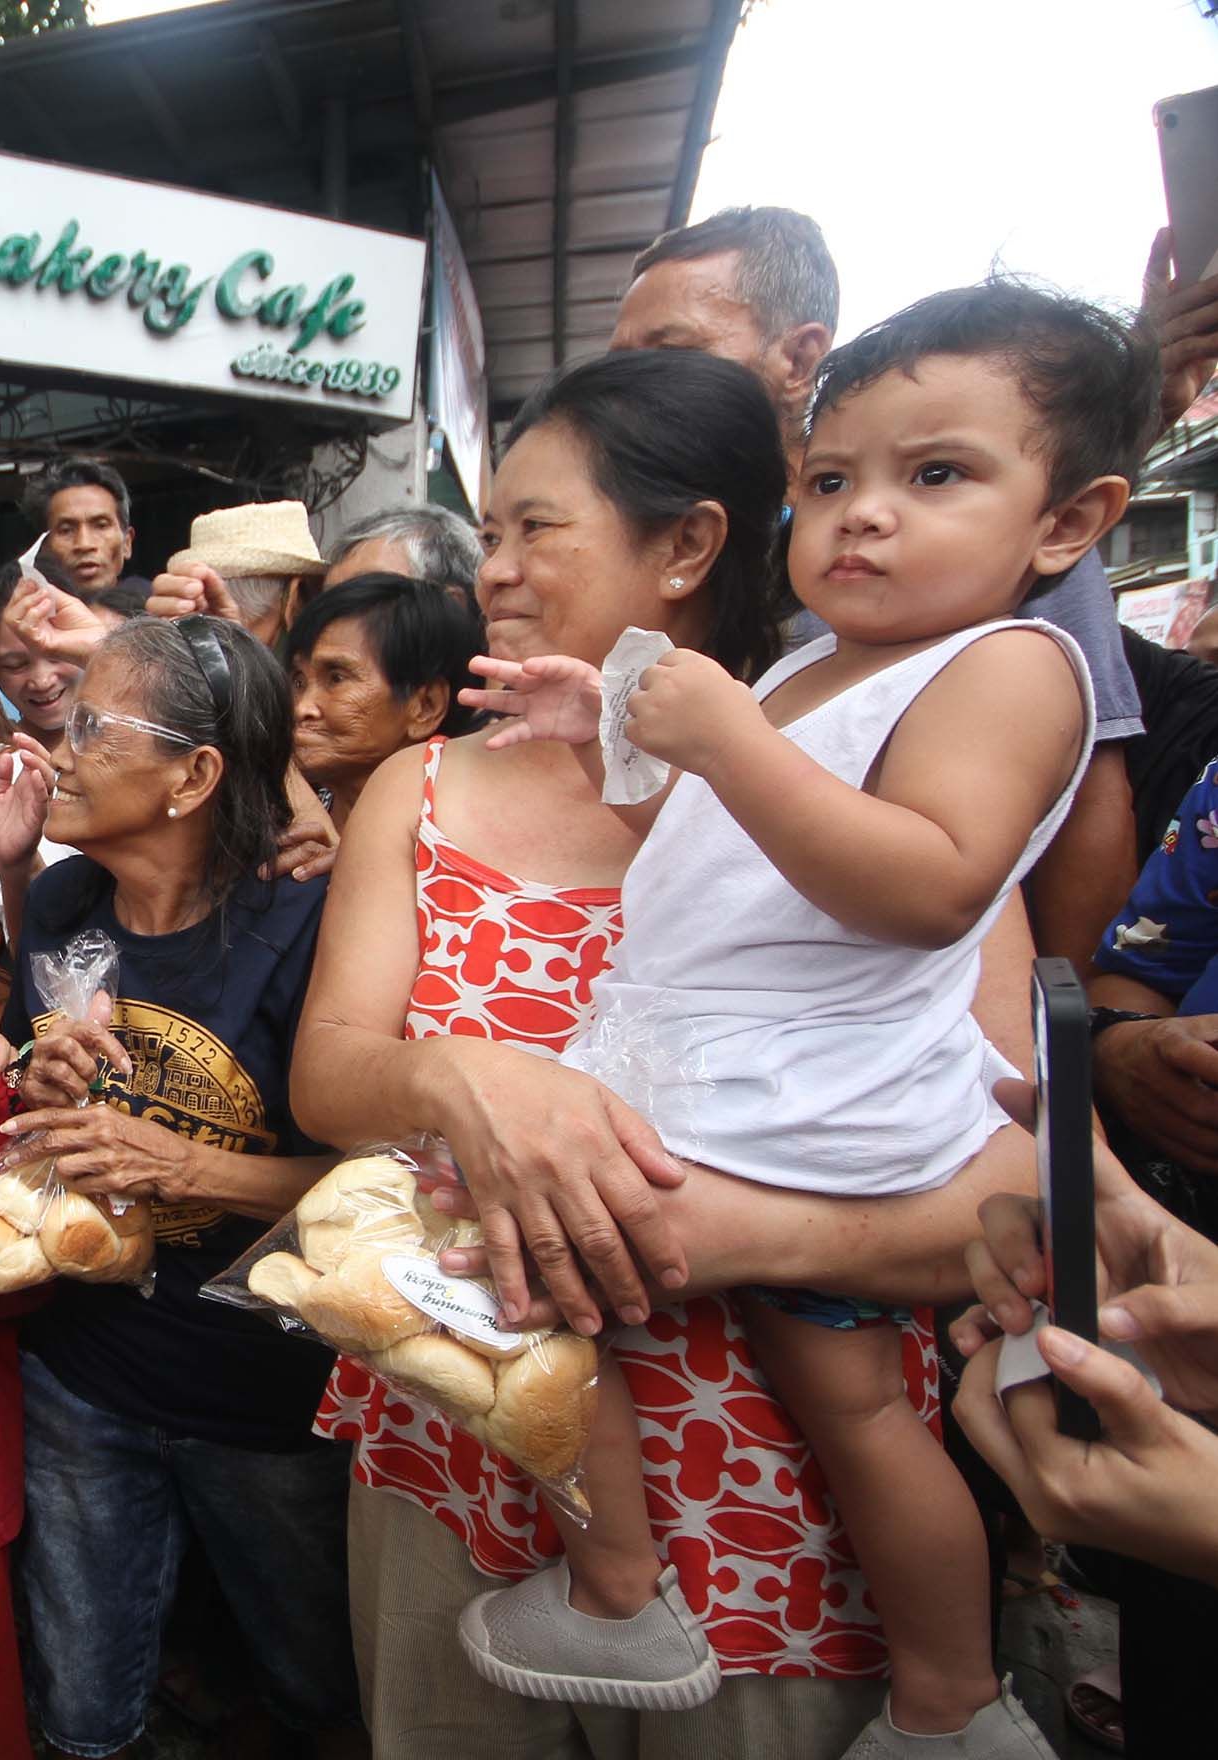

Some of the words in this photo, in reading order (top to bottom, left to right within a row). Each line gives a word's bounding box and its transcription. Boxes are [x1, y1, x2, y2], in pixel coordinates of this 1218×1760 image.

[215, 248, 365, 353] Cafe
[325, 359, 401, 396] 1939
[163, 1021, 218, 1066] 1572
[403, 1270, 454, 1300] Bakery
